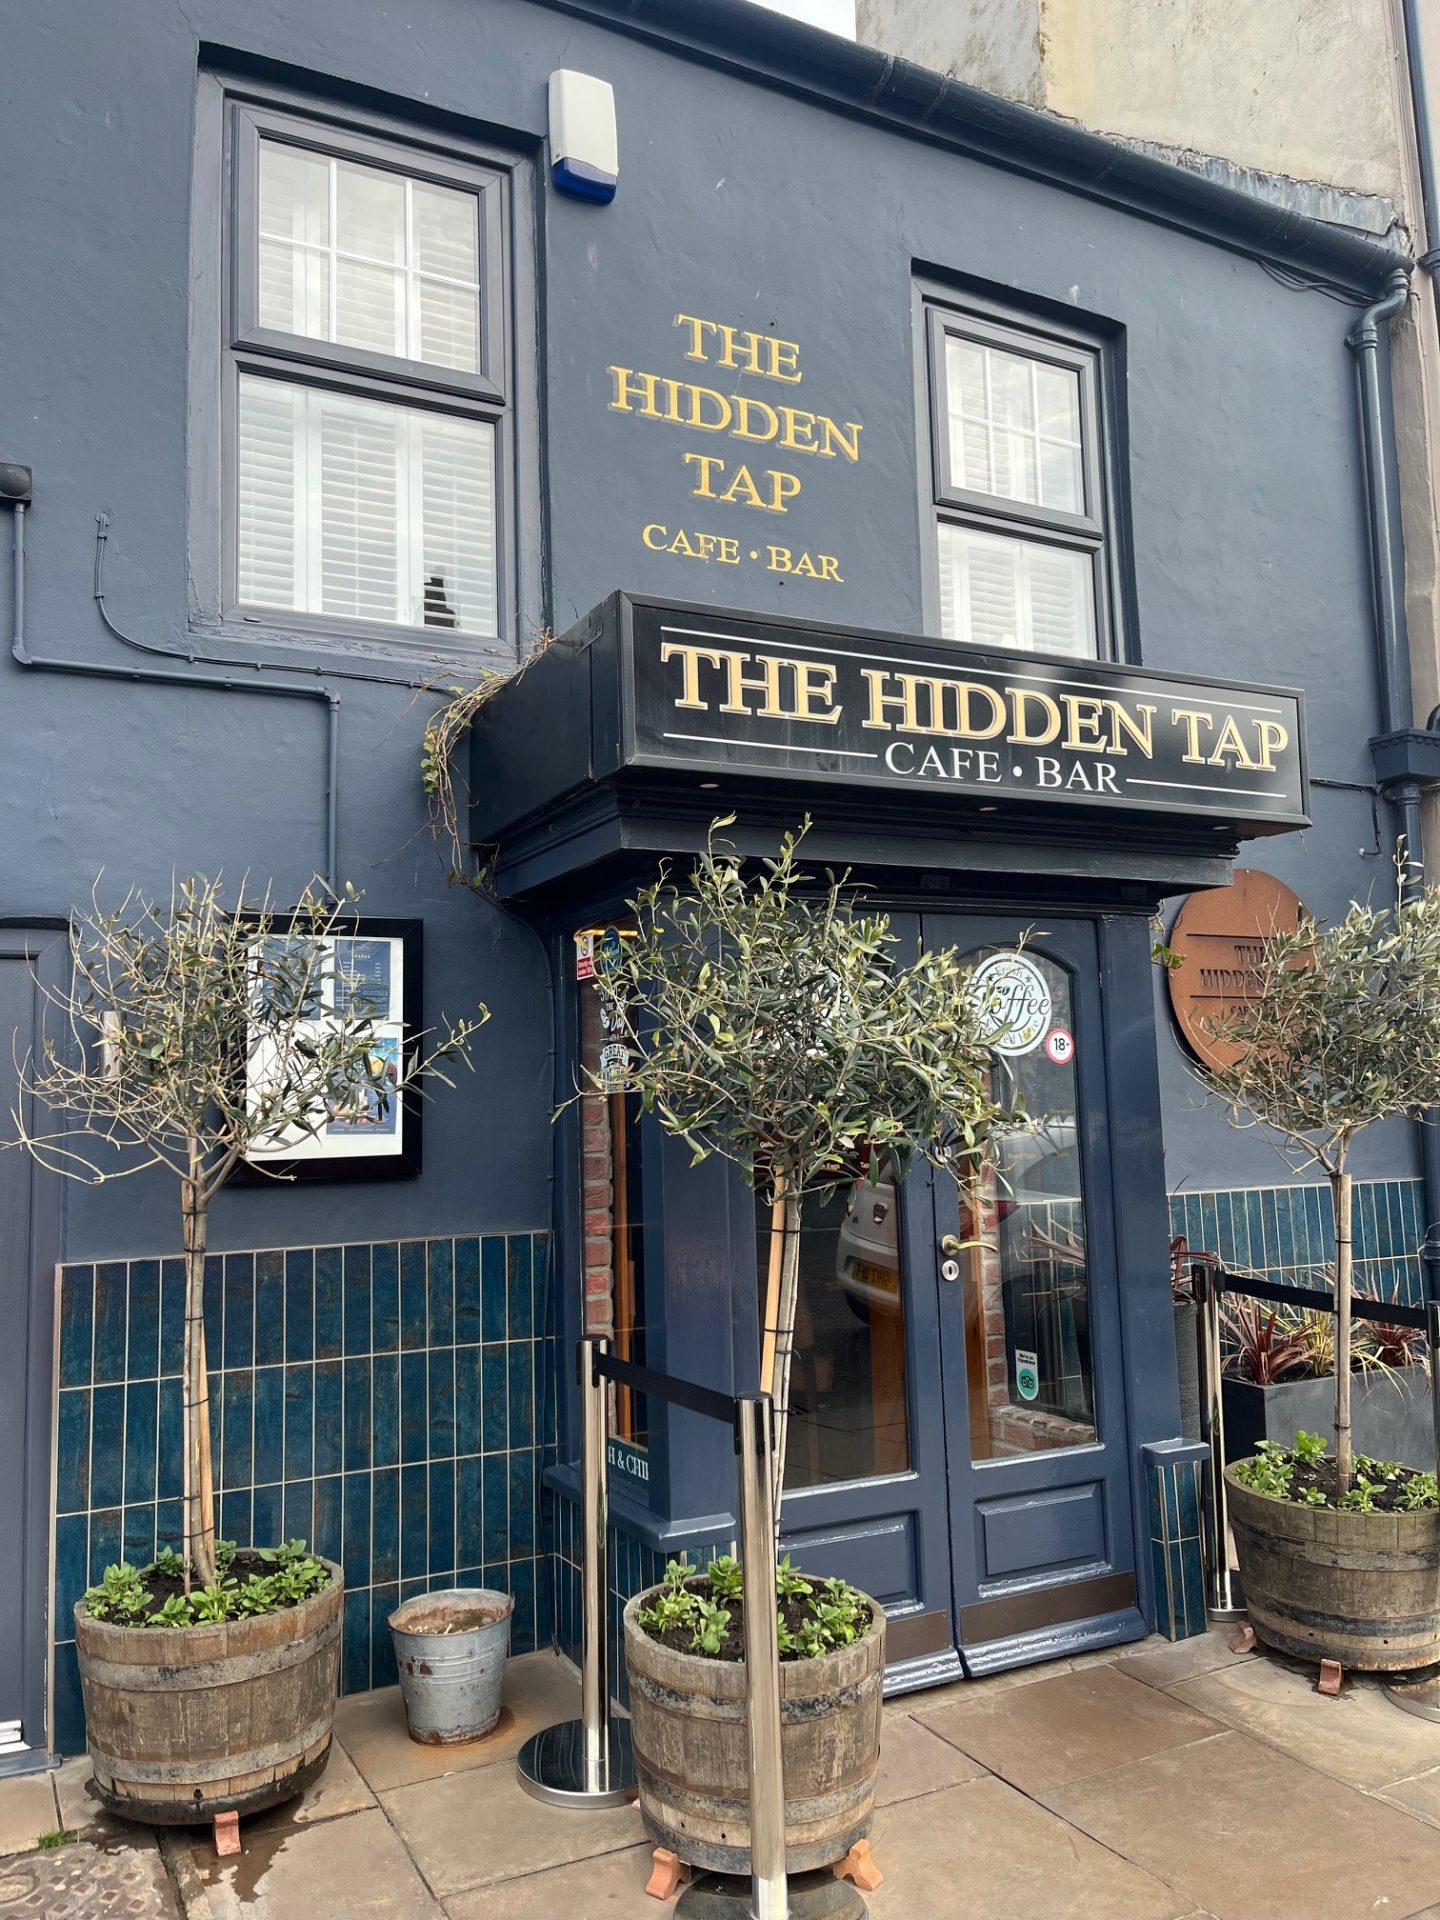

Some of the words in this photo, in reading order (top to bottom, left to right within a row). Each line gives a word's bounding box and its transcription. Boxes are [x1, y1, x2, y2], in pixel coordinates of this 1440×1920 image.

[676, 313, 802, 383] THE
[609, 365, 863, 461] HIDDEN
[684, 452, 802, 513] TAP
[642, 524, 741, 565] CAFE
[766, 545, 844, 582] BAR
[660, 641, 843, 725] THE
[860, 668, 1158, 760] HIDDEN
[1171, 708, 1288, 772] TAP
[885, 741, 1002, 783] CAFE
[1035, 756, 1122, 794] BAR
[604, 1045, 625, 1060] GREAT
[1054, 1037, 1071, 1051] 18+
